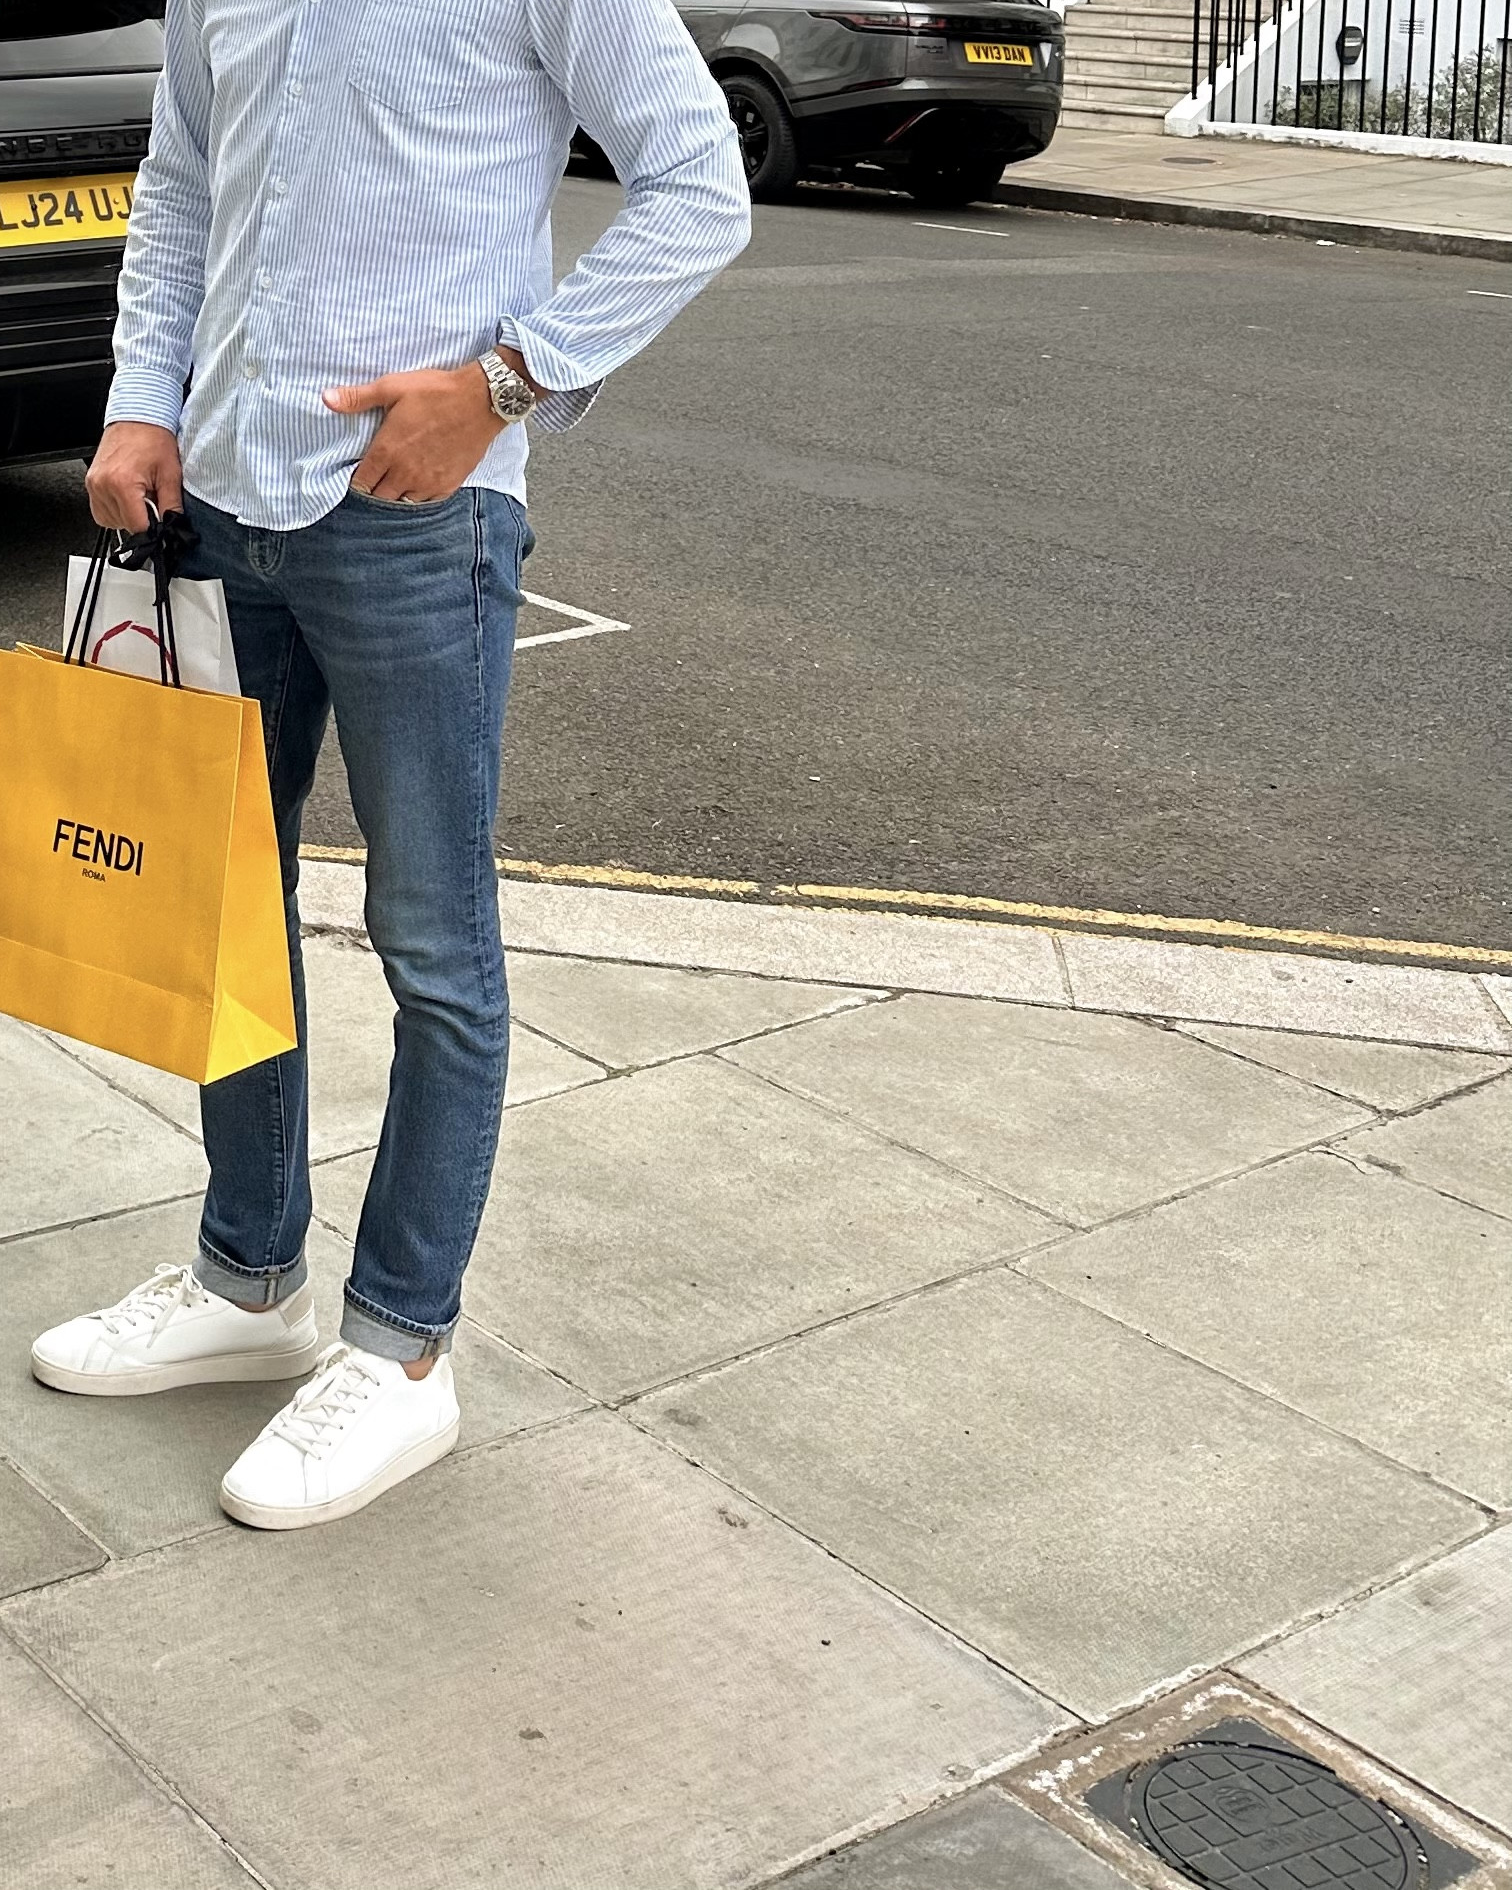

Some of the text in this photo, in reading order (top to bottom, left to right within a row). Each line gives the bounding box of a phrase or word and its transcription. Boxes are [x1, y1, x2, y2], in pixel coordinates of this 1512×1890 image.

[1002, 46, 1027, 63] DAN
[89, 185, 134, 221] UJ
[53, 818, 144, 877] FENDI
[81, 867, 106, 883] ROMA
